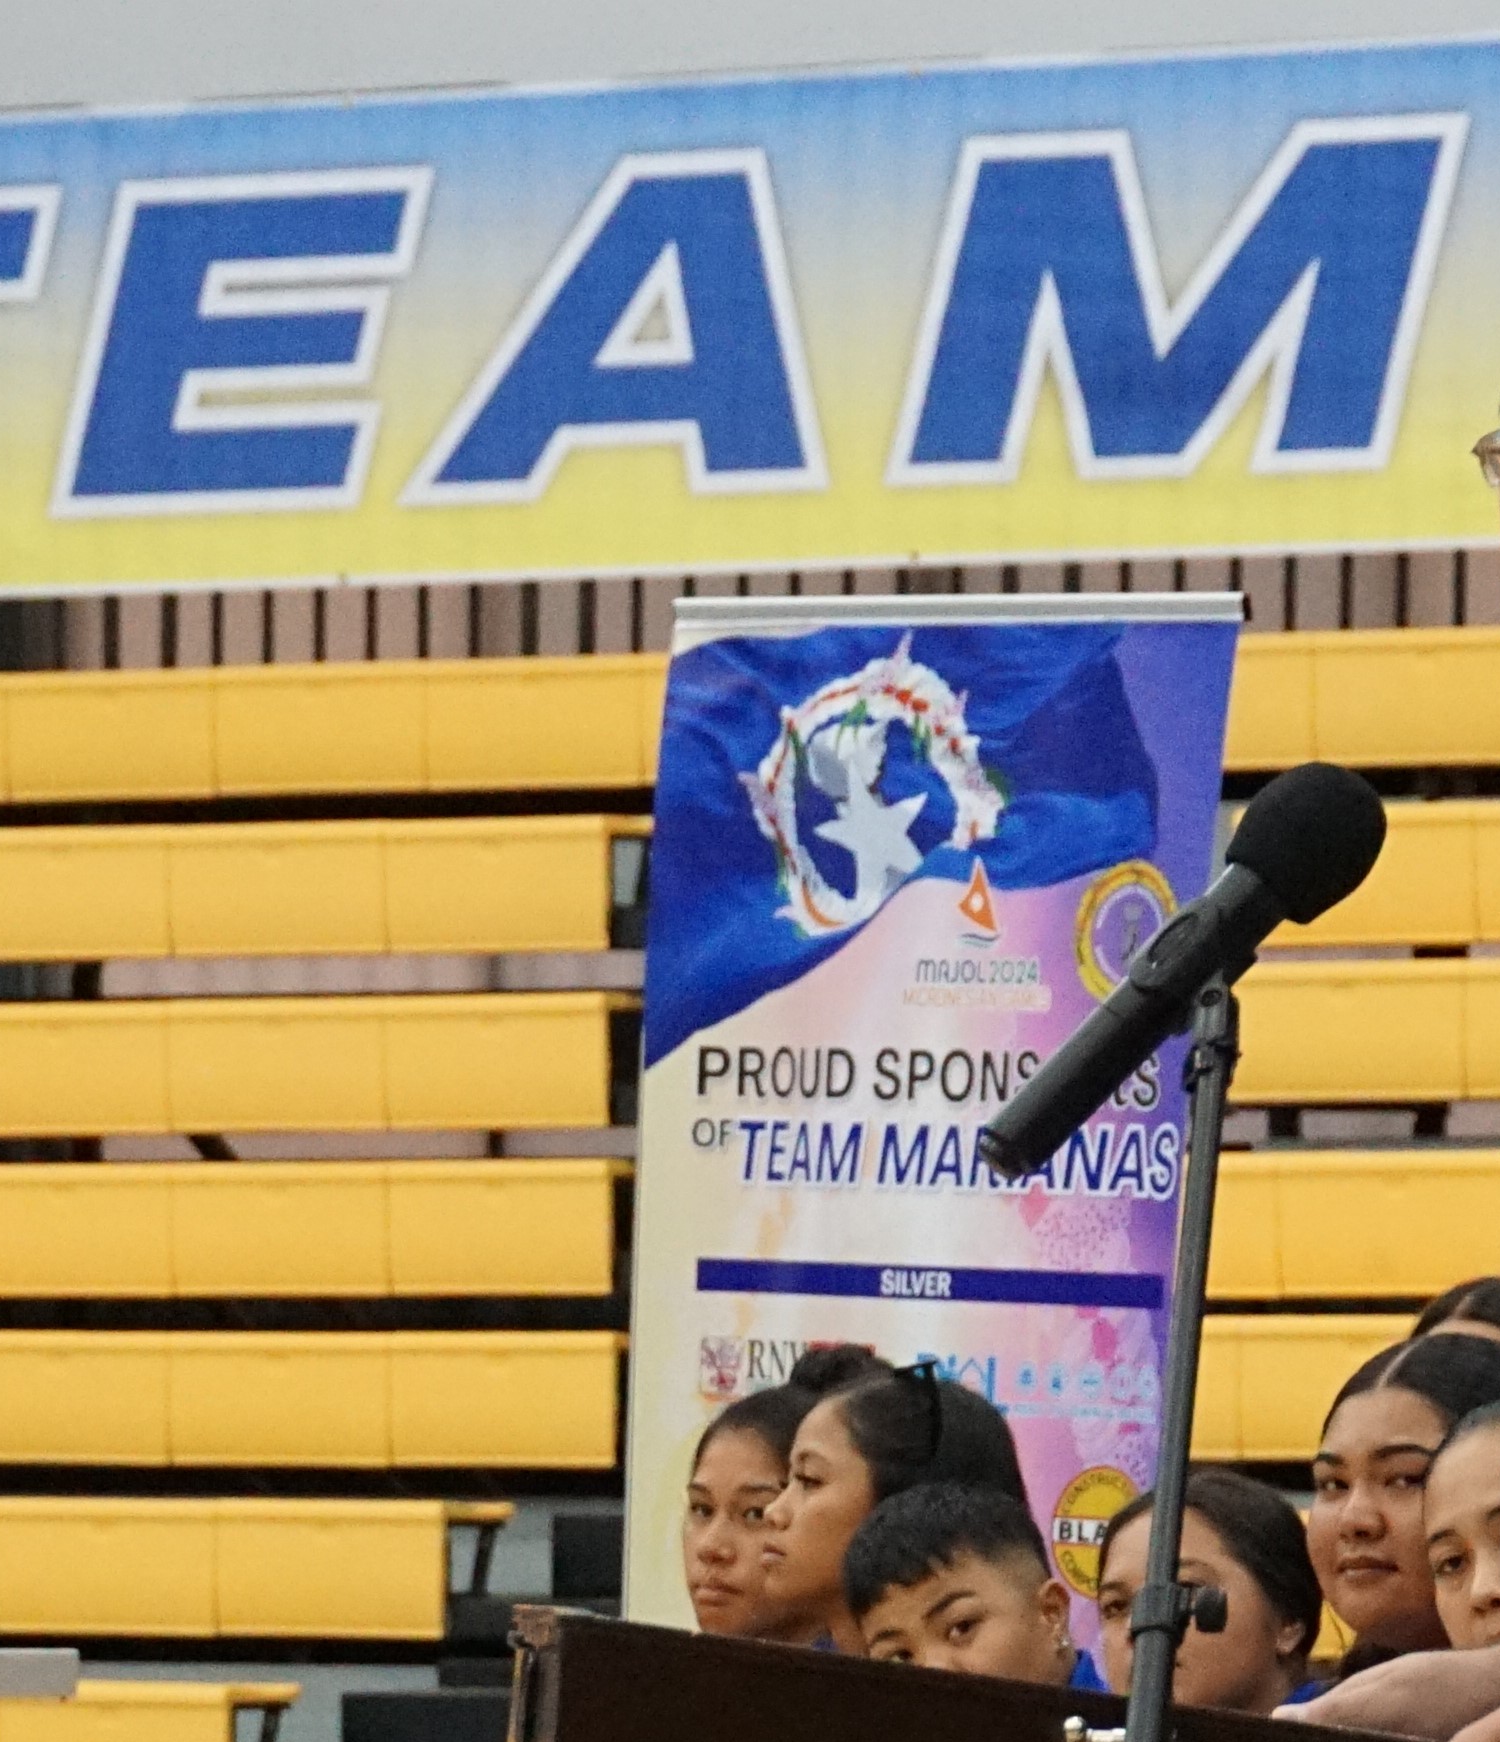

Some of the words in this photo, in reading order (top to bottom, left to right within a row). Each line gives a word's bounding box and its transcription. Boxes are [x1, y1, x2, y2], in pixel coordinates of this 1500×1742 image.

[989, 958, 1037, 985] 2024
[697, 1046, 856, 1099] PROUD
[873, 1047, 1160, 1107] SPONSS
[692, 1118, 731, 1148] OF
[738, 1120, 864, 1182] TEAM
[876, 1122, 1180, 1194] MARANAS
[880, 1267, 952, 1298] SILVER
[1059, 1520, 1108, 1541] BLA
